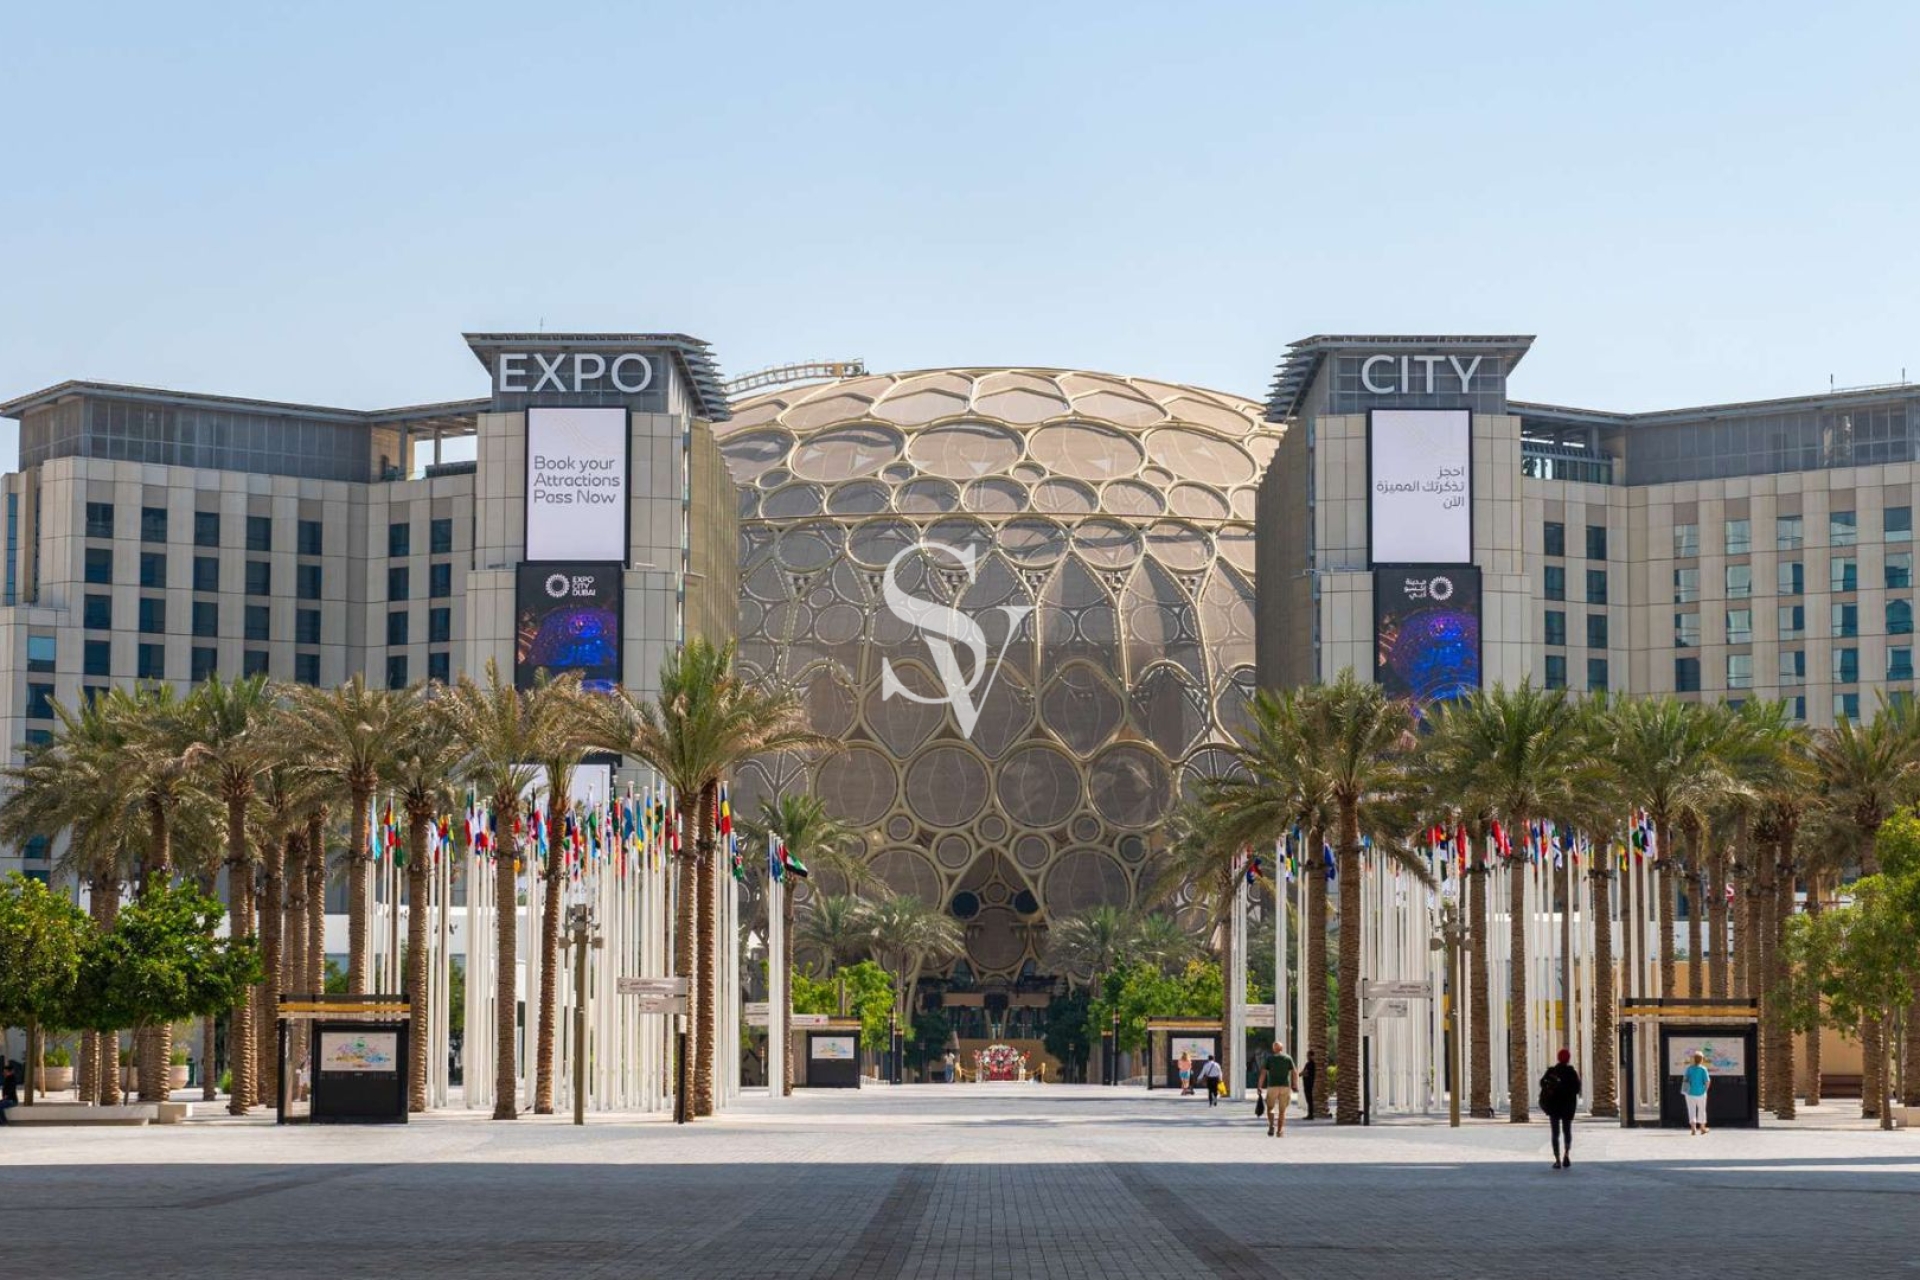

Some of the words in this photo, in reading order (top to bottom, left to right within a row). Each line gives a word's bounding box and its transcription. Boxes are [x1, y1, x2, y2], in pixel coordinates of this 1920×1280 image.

[499, 353, 653, 393] EXPO
[1361, 354, 1483, 394] CITY
[534, 455, 576, 470] Book
[579, 458, 615, 474] your
[533, 472, 621, 487] Attractions
[533, 489, 573, 504] Pass
[576, 489, 616, 504] Now
